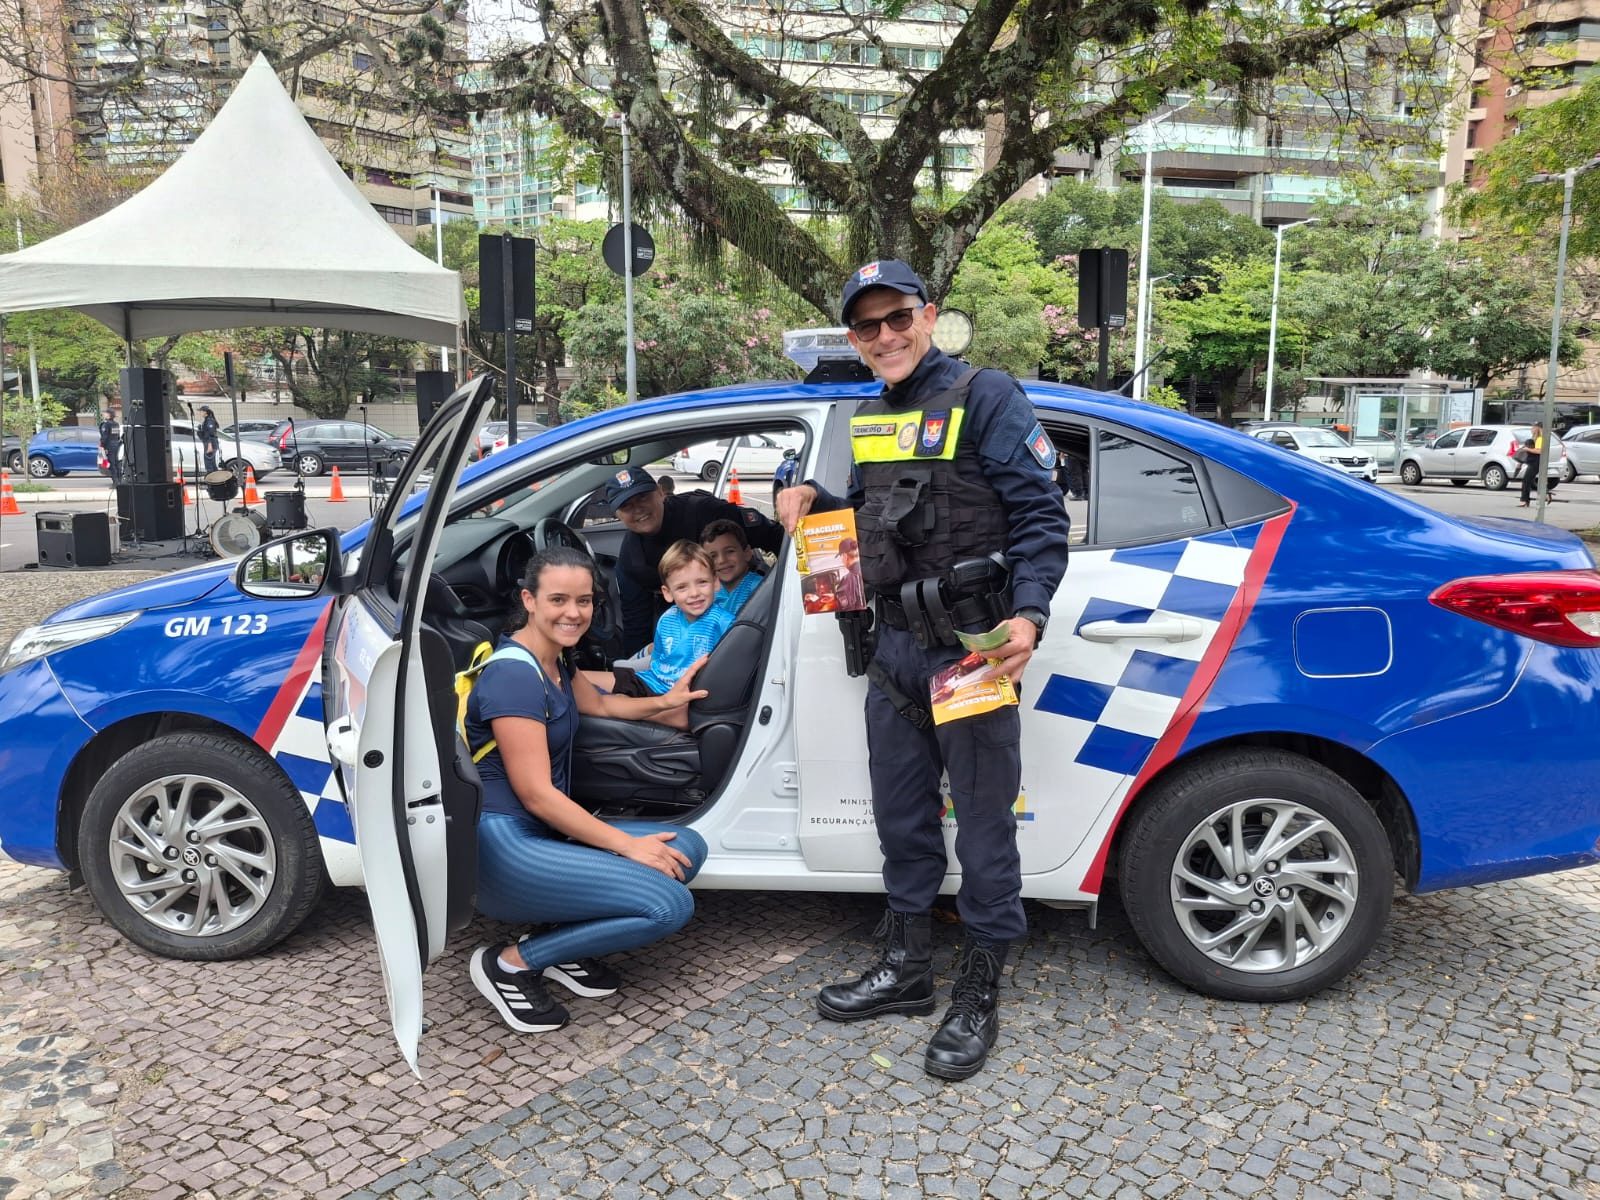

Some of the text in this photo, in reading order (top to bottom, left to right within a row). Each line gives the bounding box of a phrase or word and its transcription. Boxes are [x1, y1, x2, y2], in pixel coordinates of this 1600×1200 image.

[164, 613, 269, 638] GM 123
[810, 817, 867, 826] SEGURANÇA
